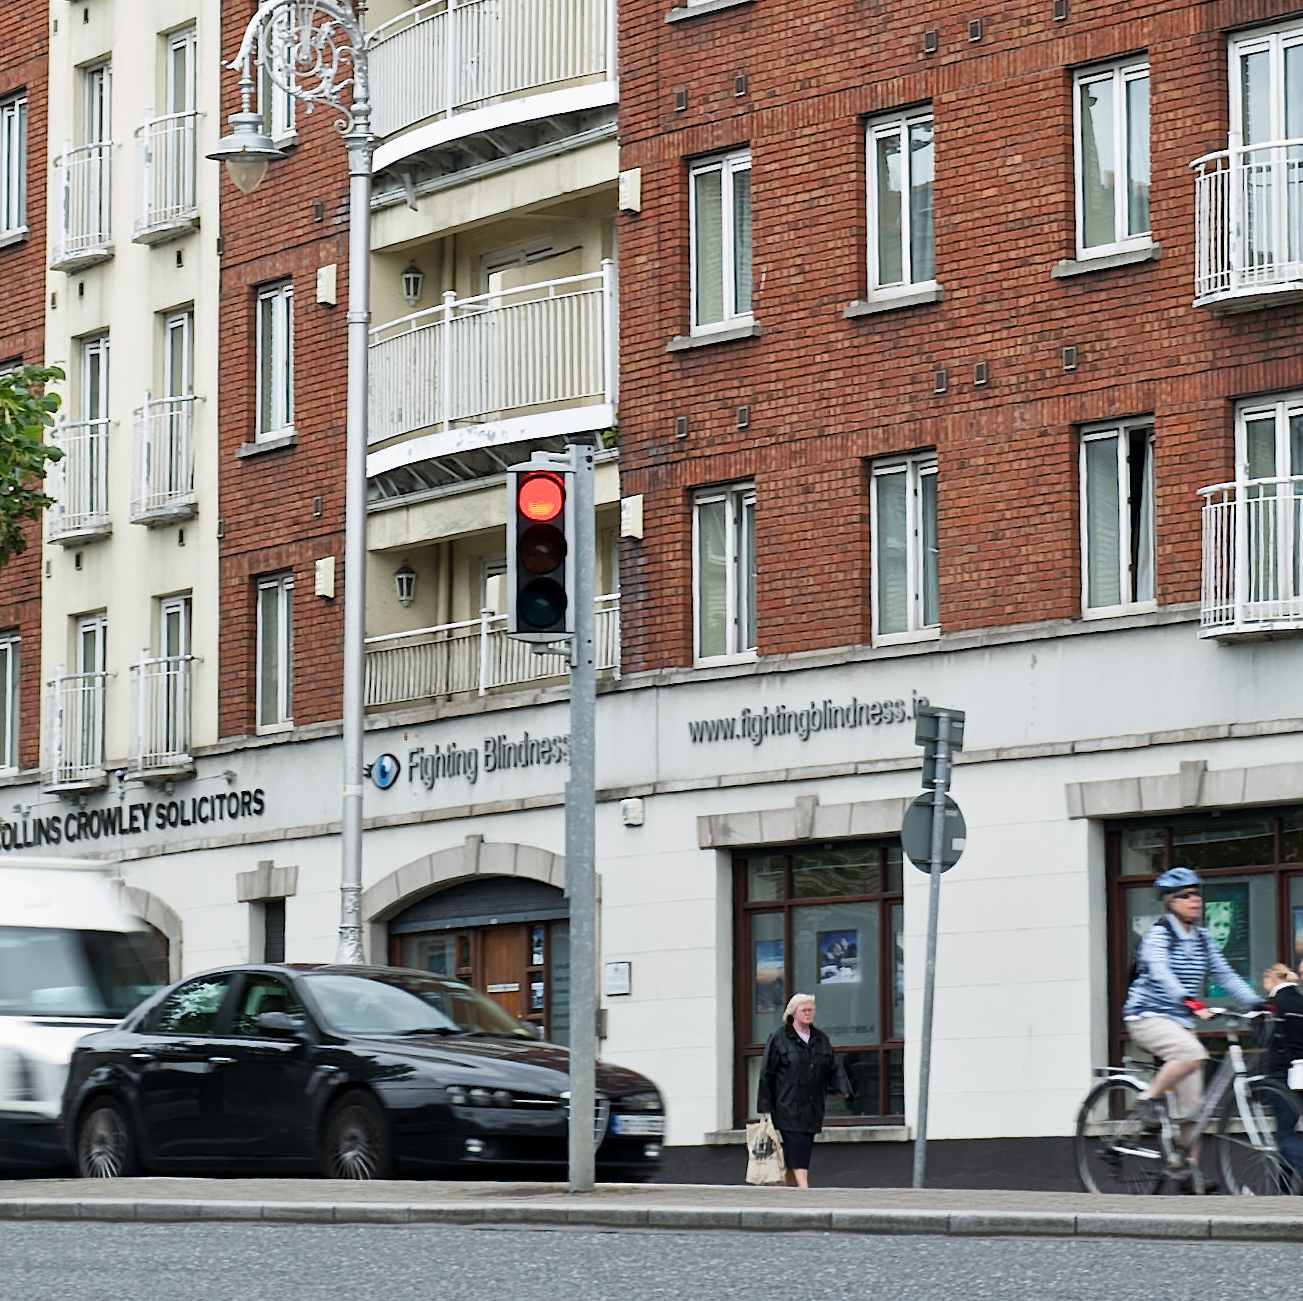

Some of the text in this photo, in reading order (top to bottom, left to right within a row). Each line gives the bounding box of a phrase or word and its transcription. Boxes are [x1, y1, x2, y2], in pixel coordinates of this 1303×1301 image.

[408, 741, 479, 791] Fighting
[64, 802, 153, 842] CROWLEY
[155, 788, 266, 830] SOLICITORS
